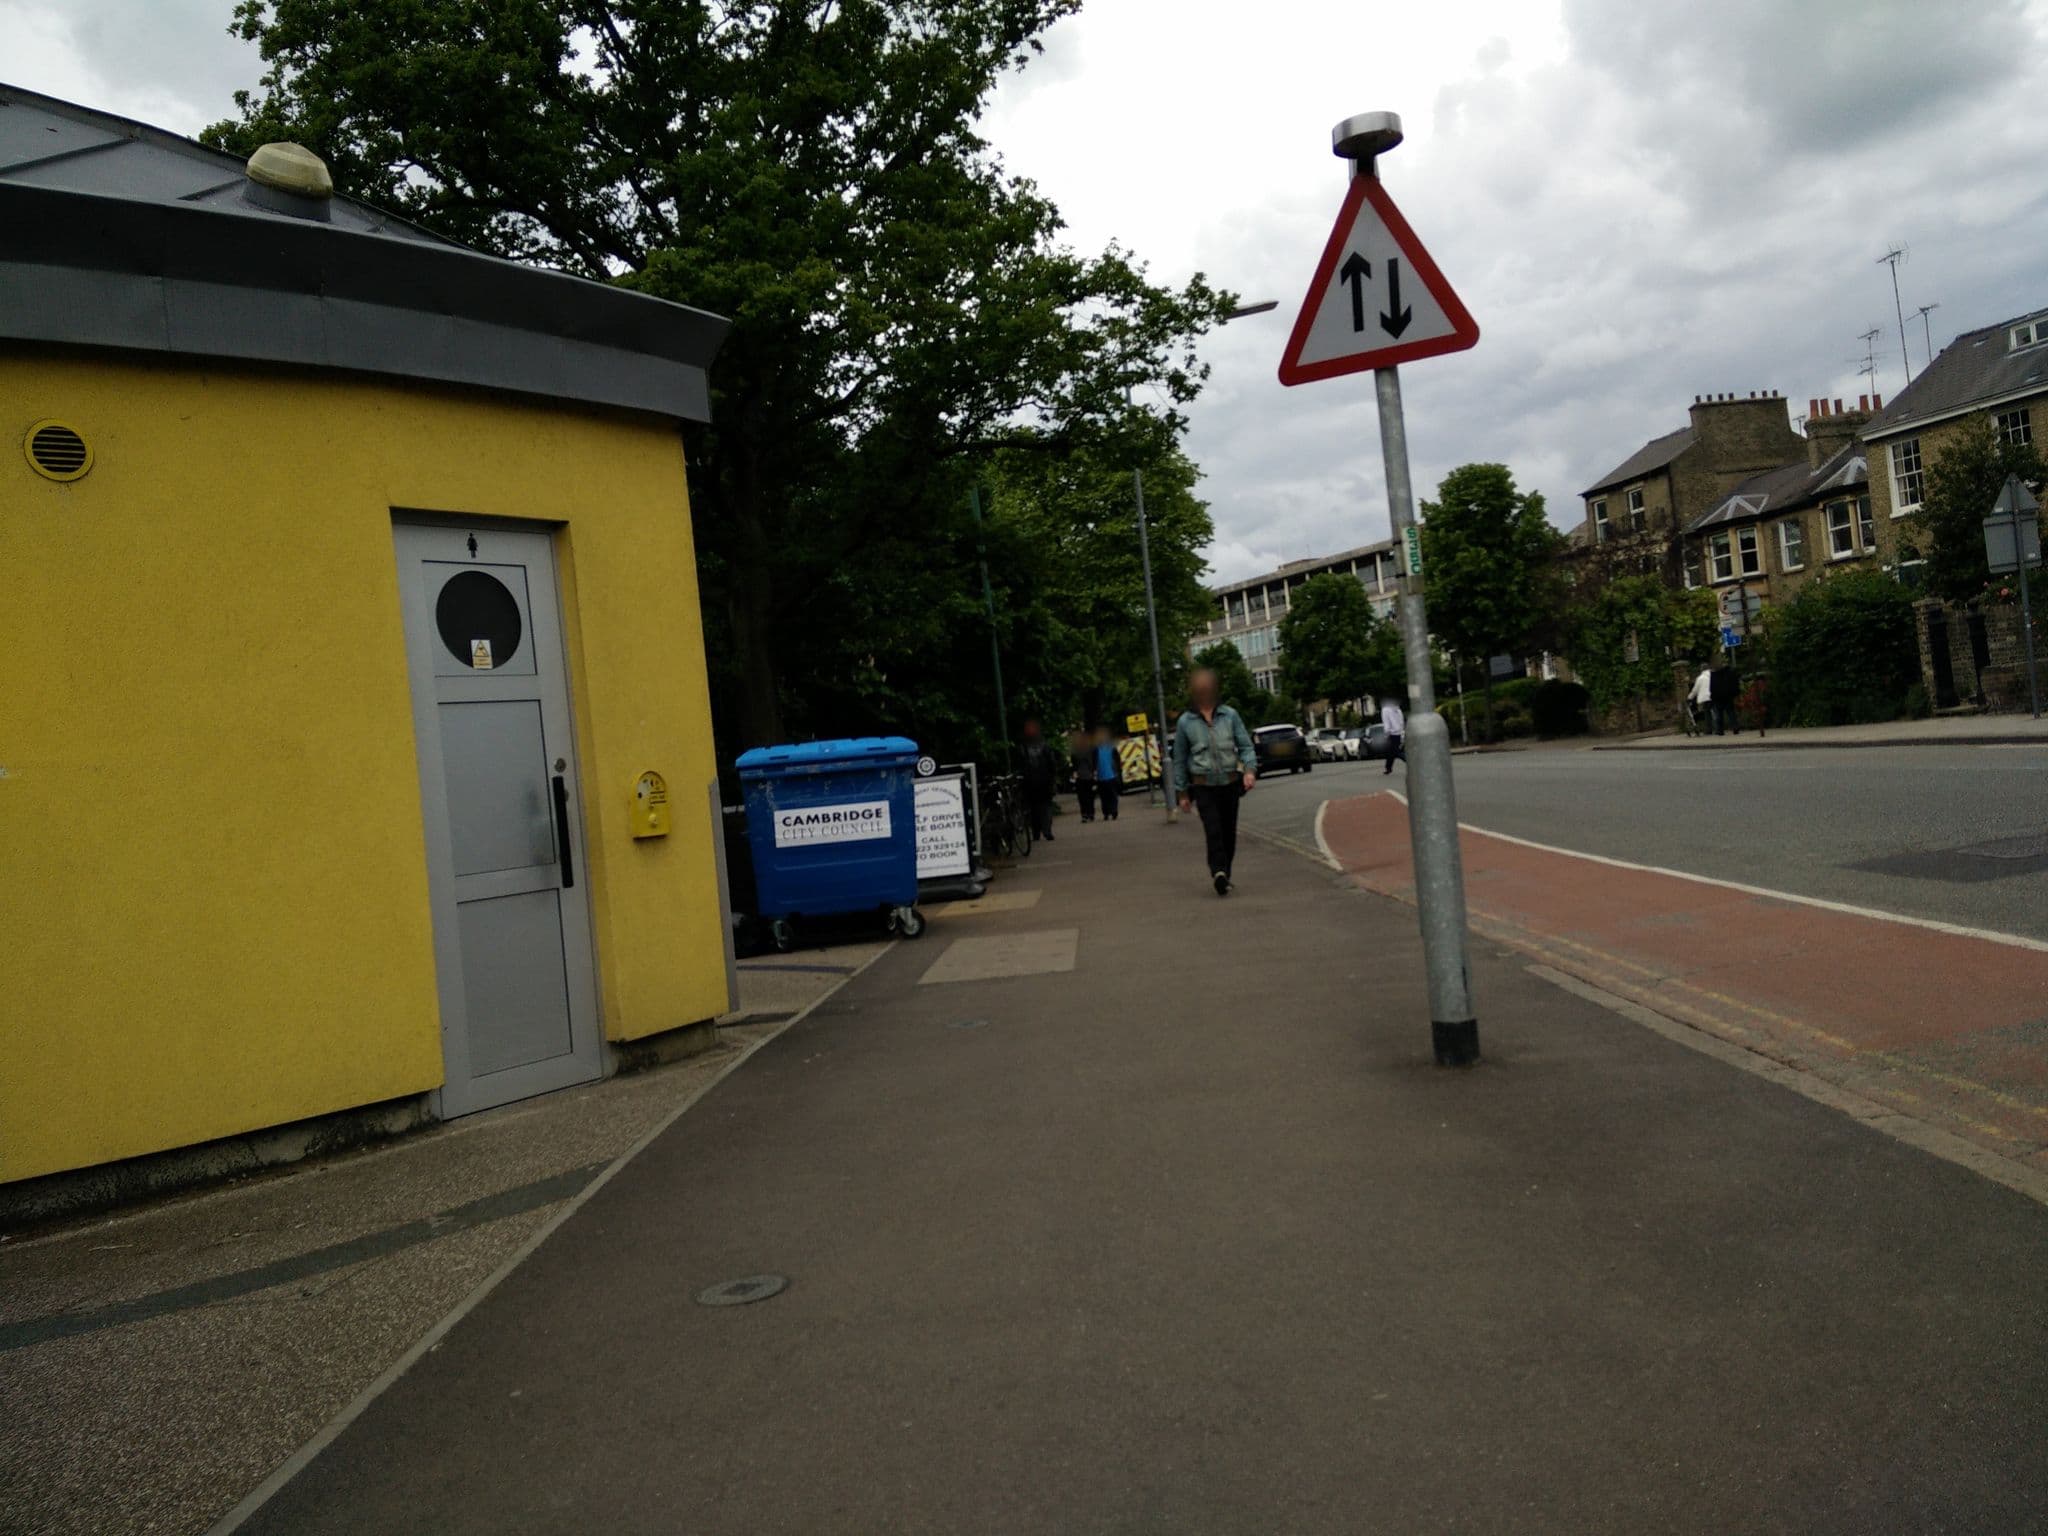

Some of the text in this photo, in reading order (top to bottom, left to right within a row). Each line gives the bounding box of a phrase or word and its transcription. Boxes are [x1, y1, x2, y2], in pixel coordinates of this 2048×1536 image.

[782, 808, 883, 827] CAMBRIDGE
[931, 812, 962, 822] DRIVE
[782, 821, 883, 840] CITY COUNCIL
[930, 820, 965, 831] BOATS
[921, 836, 945, 844] CALL
[929, 849, 957, 859] BOOK
